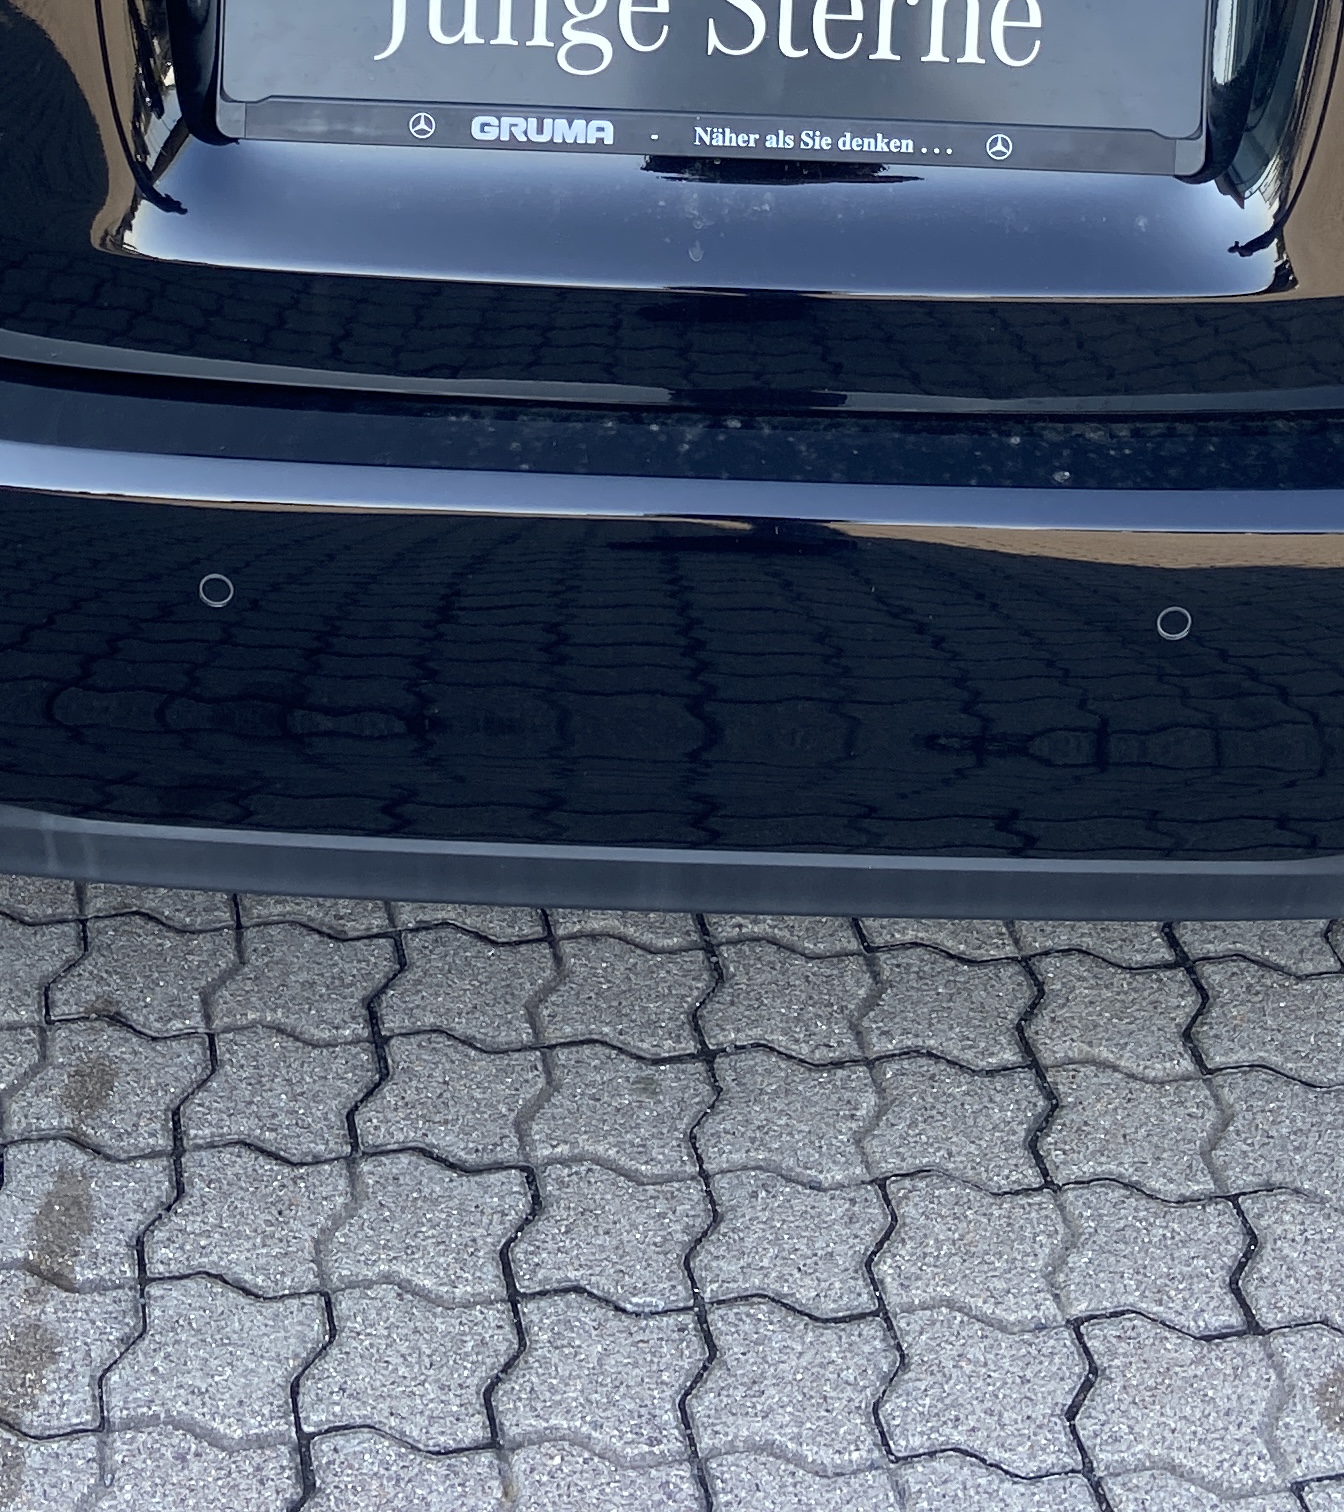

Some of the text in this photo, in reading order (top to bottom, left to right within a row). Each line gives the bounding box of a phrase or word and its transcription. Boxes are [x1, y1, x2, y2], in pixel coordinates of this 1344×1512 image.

[470, 116, 614, 145] GRUMA
[694, 126, 759, 149] Näher
[765, 129, 795, 149] als
[800, 130, 832, 151] Sie
[837, 131, 914, 154] denken
